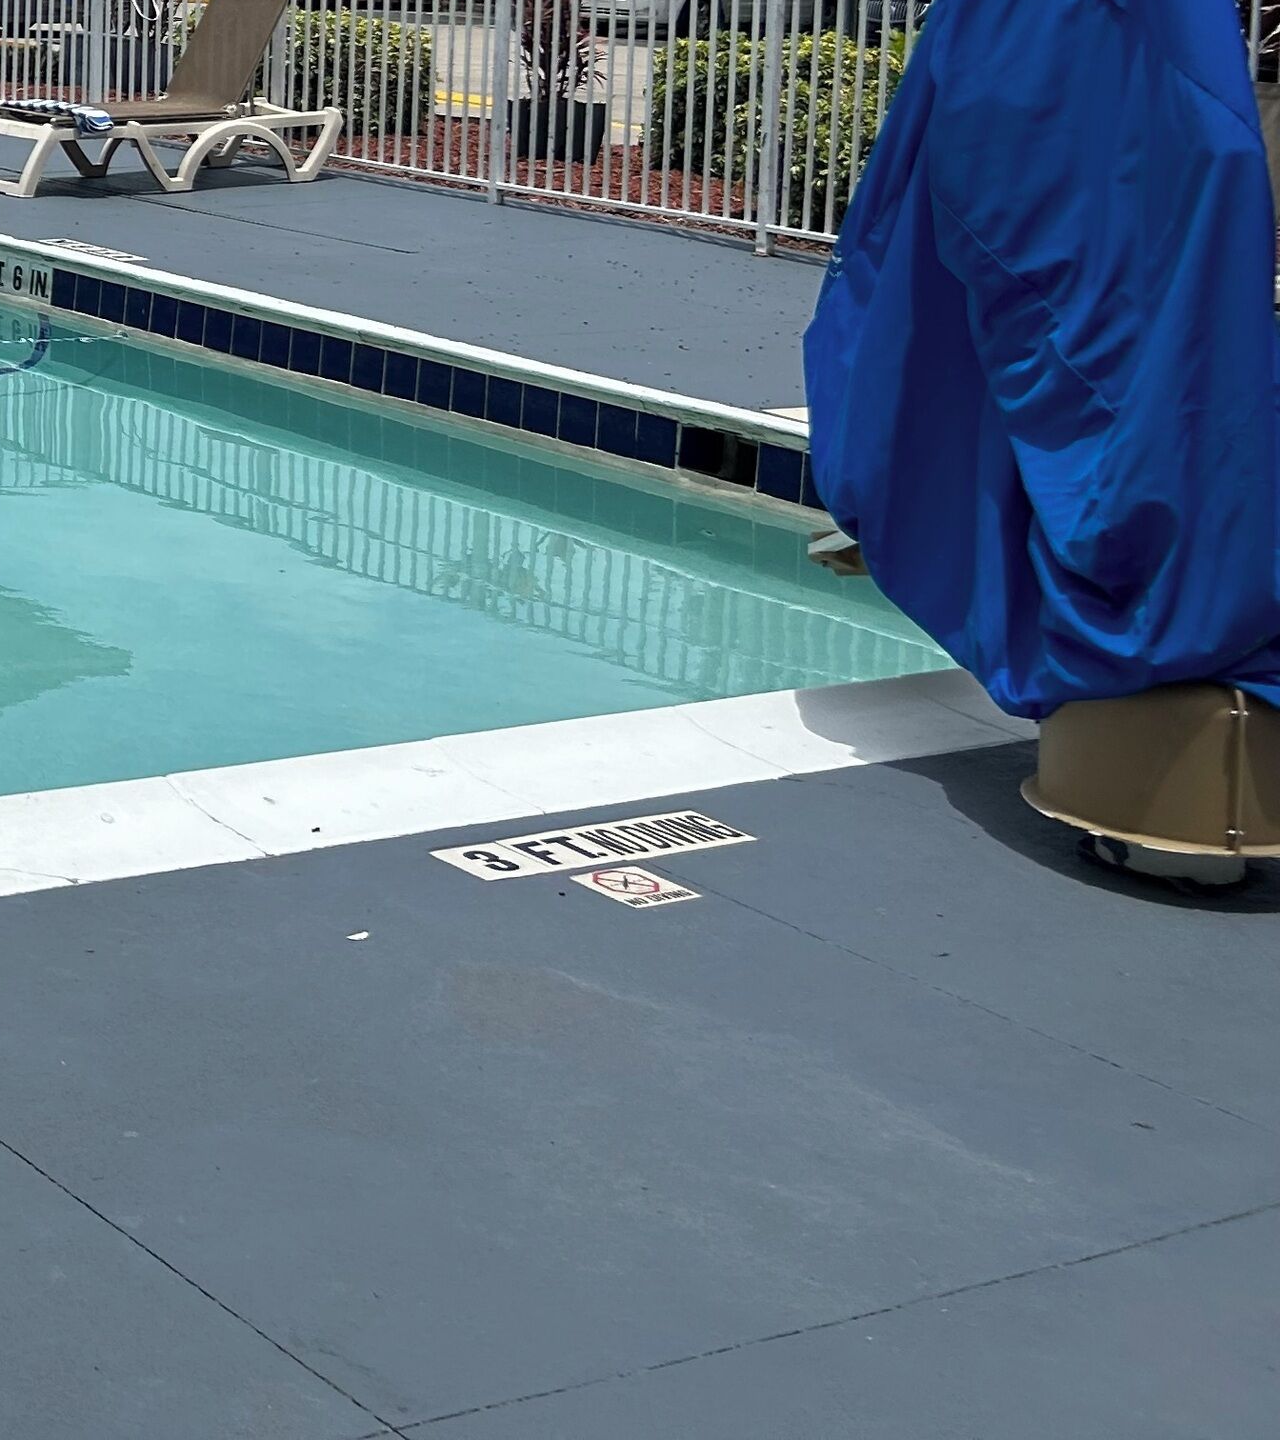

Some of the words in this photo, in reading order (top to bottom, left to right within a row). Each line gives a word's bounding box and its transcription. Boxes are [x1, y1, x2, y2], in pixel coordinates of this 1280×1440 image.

[12, 265, 22, 291] 6
[29, 269, 49, 299] IN.
[462, 850, 521, 872] 3
[512, 836, 610, 865] FT.
